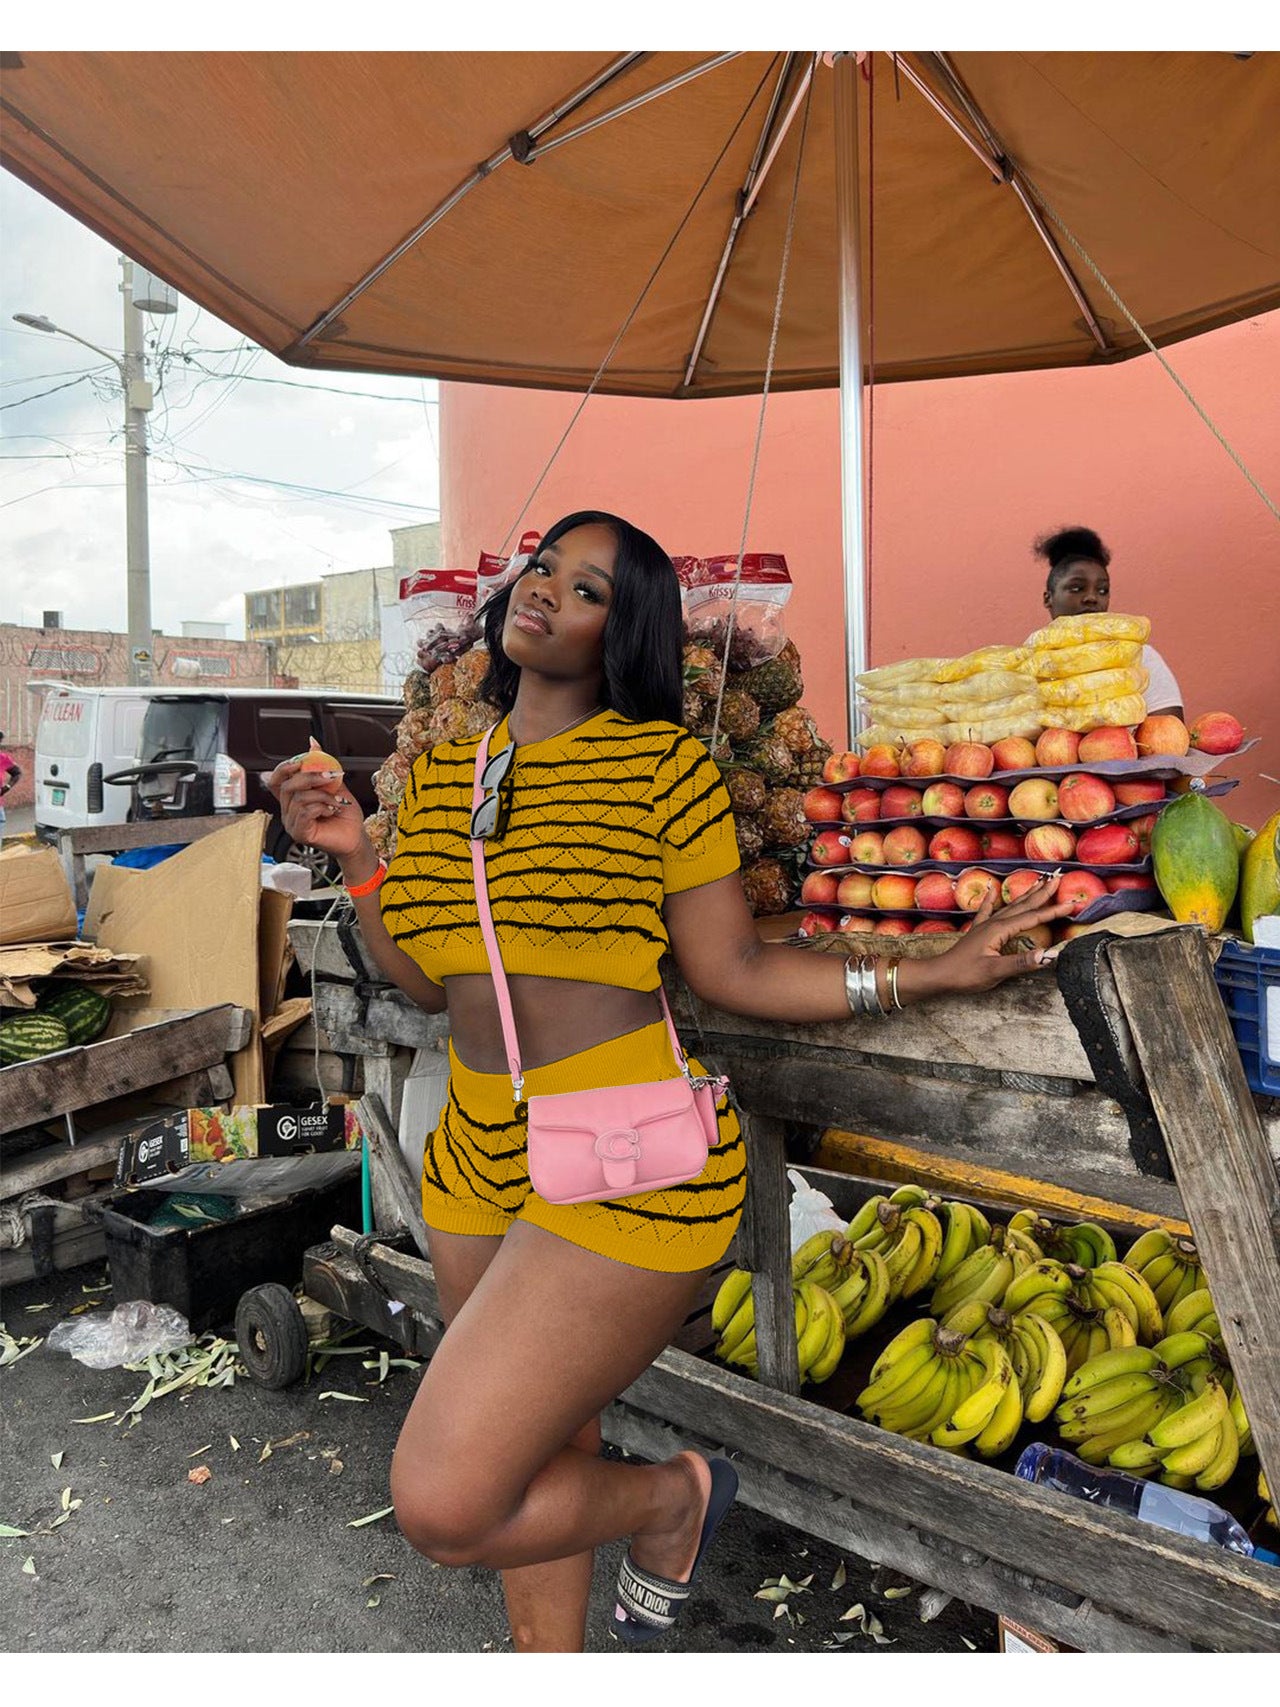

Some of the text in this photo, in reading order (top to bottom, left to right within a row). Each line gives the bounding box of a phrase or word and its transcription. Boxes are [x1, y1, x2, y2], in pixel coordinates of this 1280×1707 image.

[456, 594, 476, 609] Kriss
[300, 1116, 328, 1126] GESEX
[643, 1591, 671, 1616] DIOR
